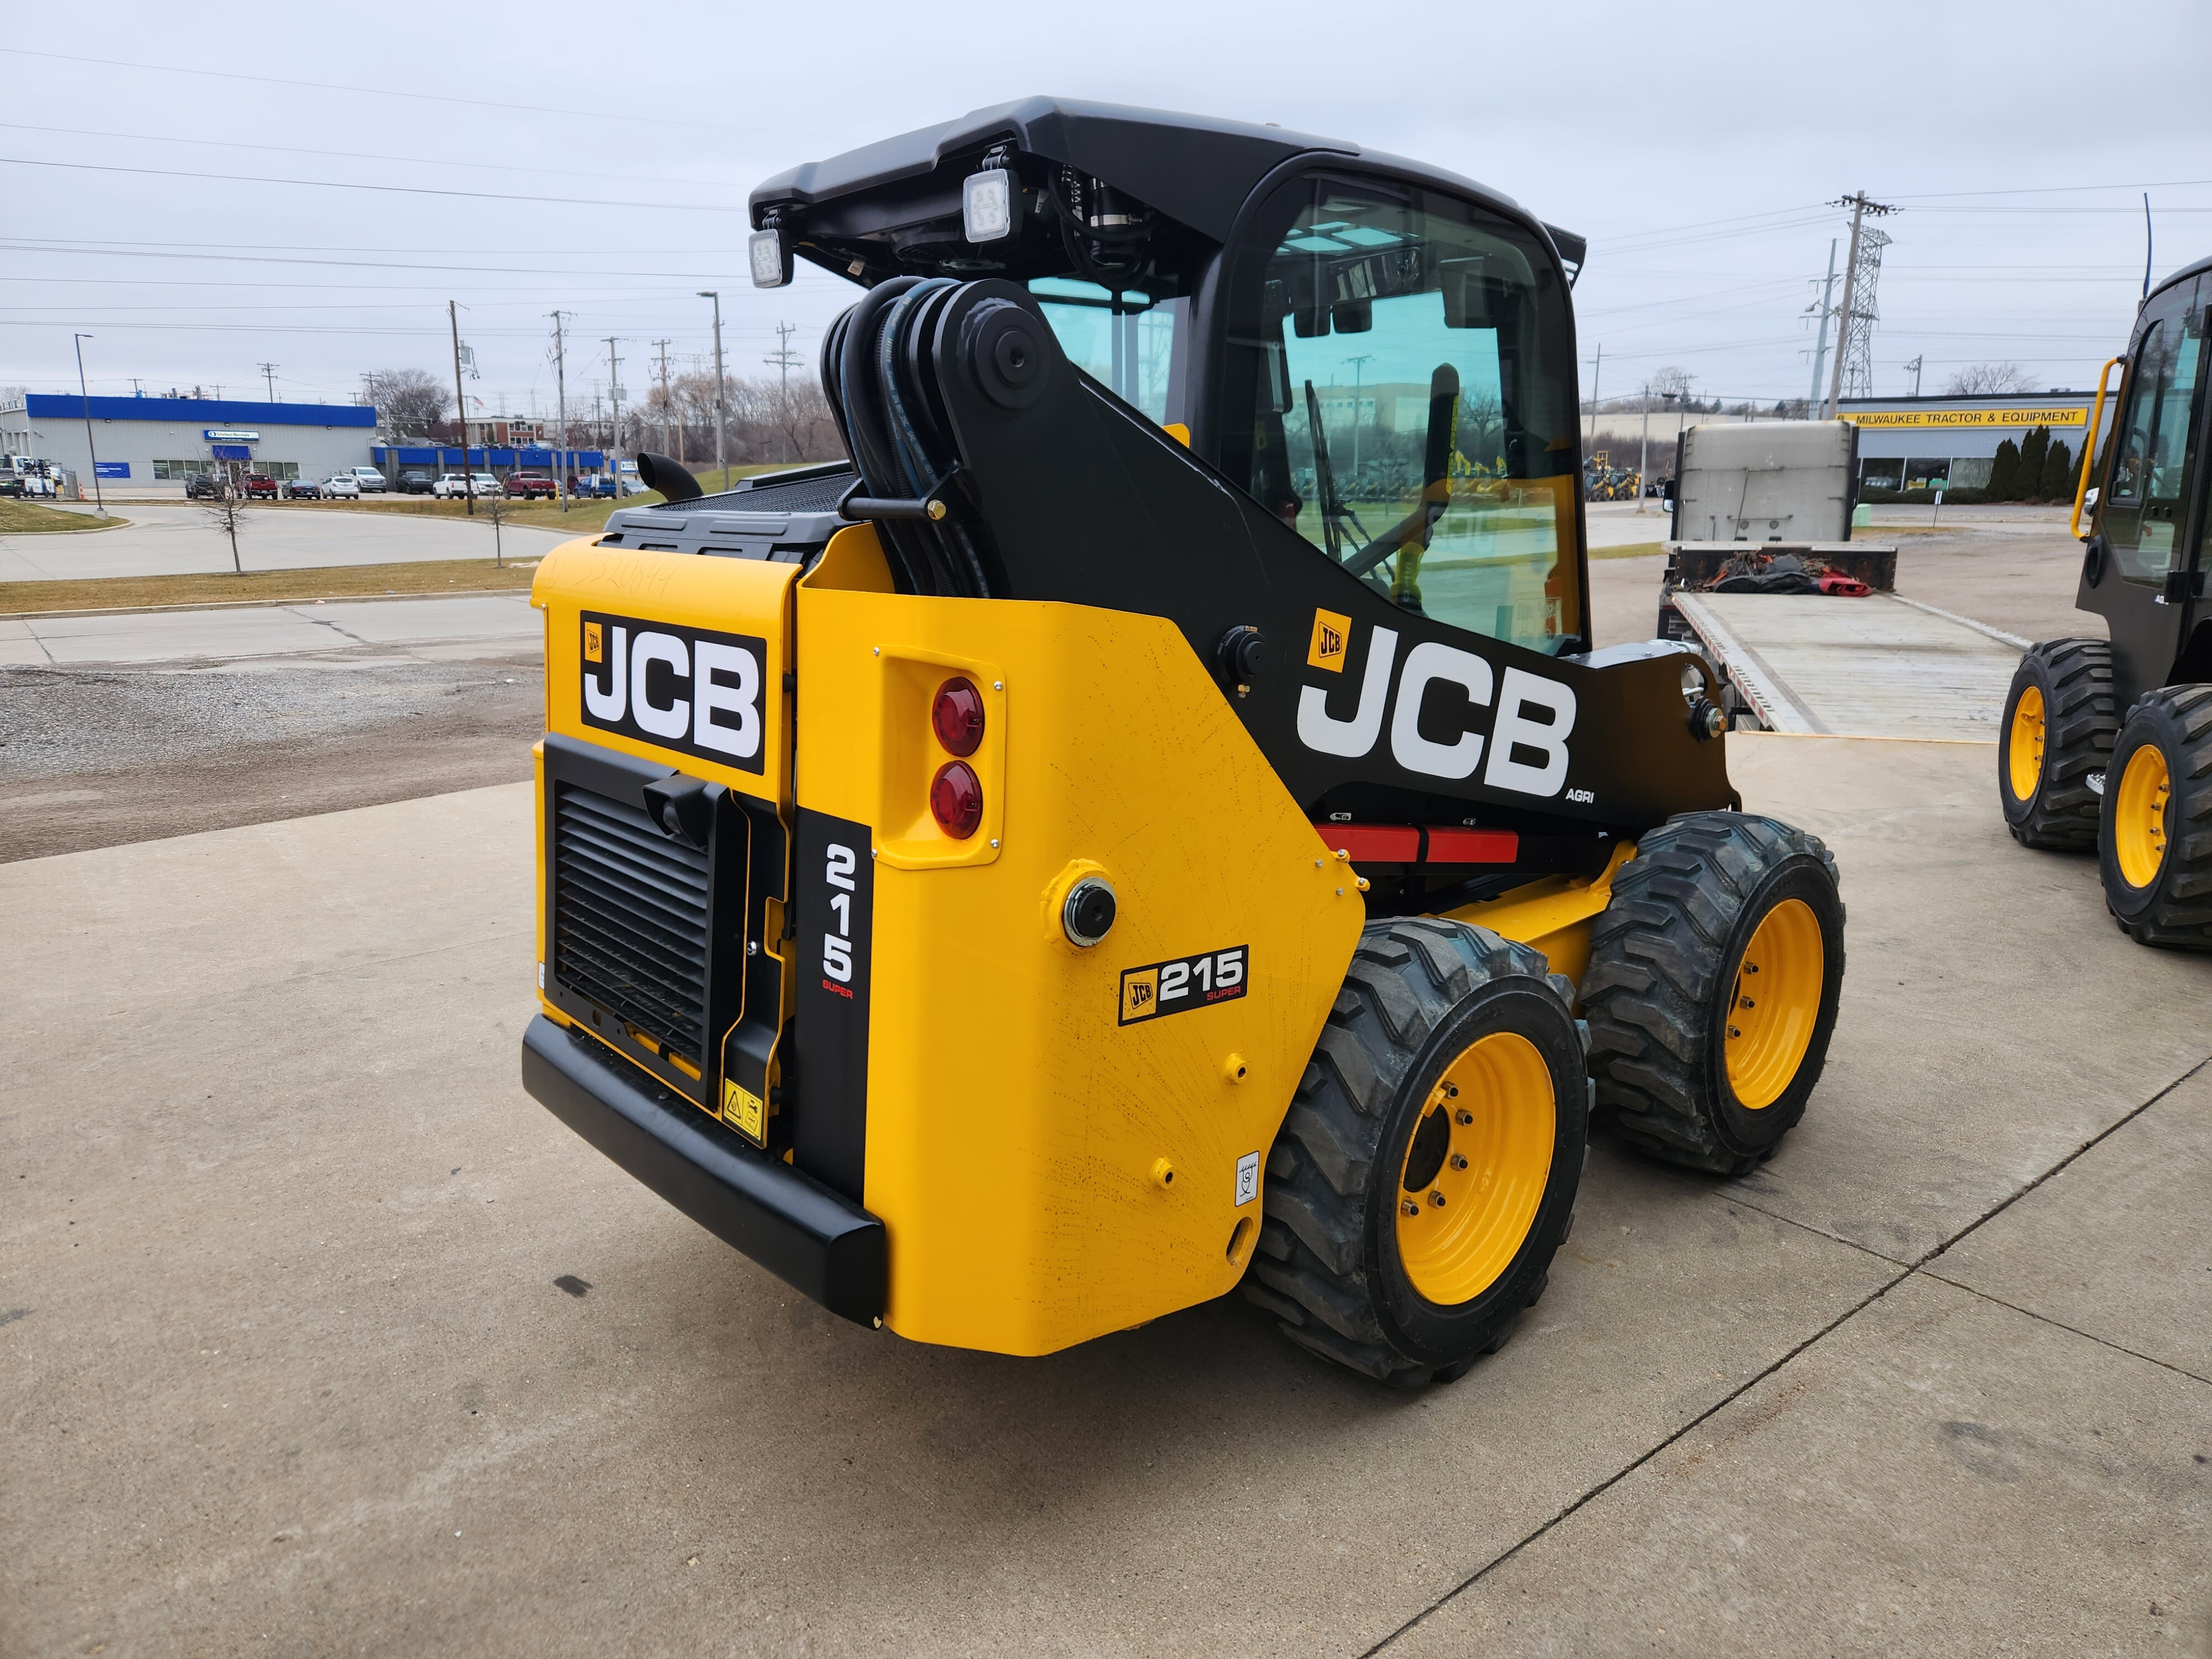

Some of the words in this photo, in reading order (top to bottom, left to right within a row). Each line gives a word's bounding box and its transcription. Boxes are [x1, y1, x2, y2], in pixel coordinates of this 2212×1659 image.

[1856, 414, 1921, 424] MILWAUKEE
[1926, 413, 1982, 423] TRACTOR
[1987, 413, 1996, 422] &
[2002, 411, 2079, 422] EQUIPMENT
[907, 430, 917, 442] SAE
[589, 632, 599, 651] JCB
[1320, 627, 1340, 654] JCB
[585, 626, 760, 758] JCB
[1297, 625, 1577, 797] JCB
[1565, 788, 1594, 804] AGRI
[823, 843, 856, 983] 215
[1160, 950, 1243, 1001] 215
[822, 979, 853, 999] SUPER
[1132, 984, 1151, 1006] JCB
[1206, 985, 1241, 1001] SUPER
